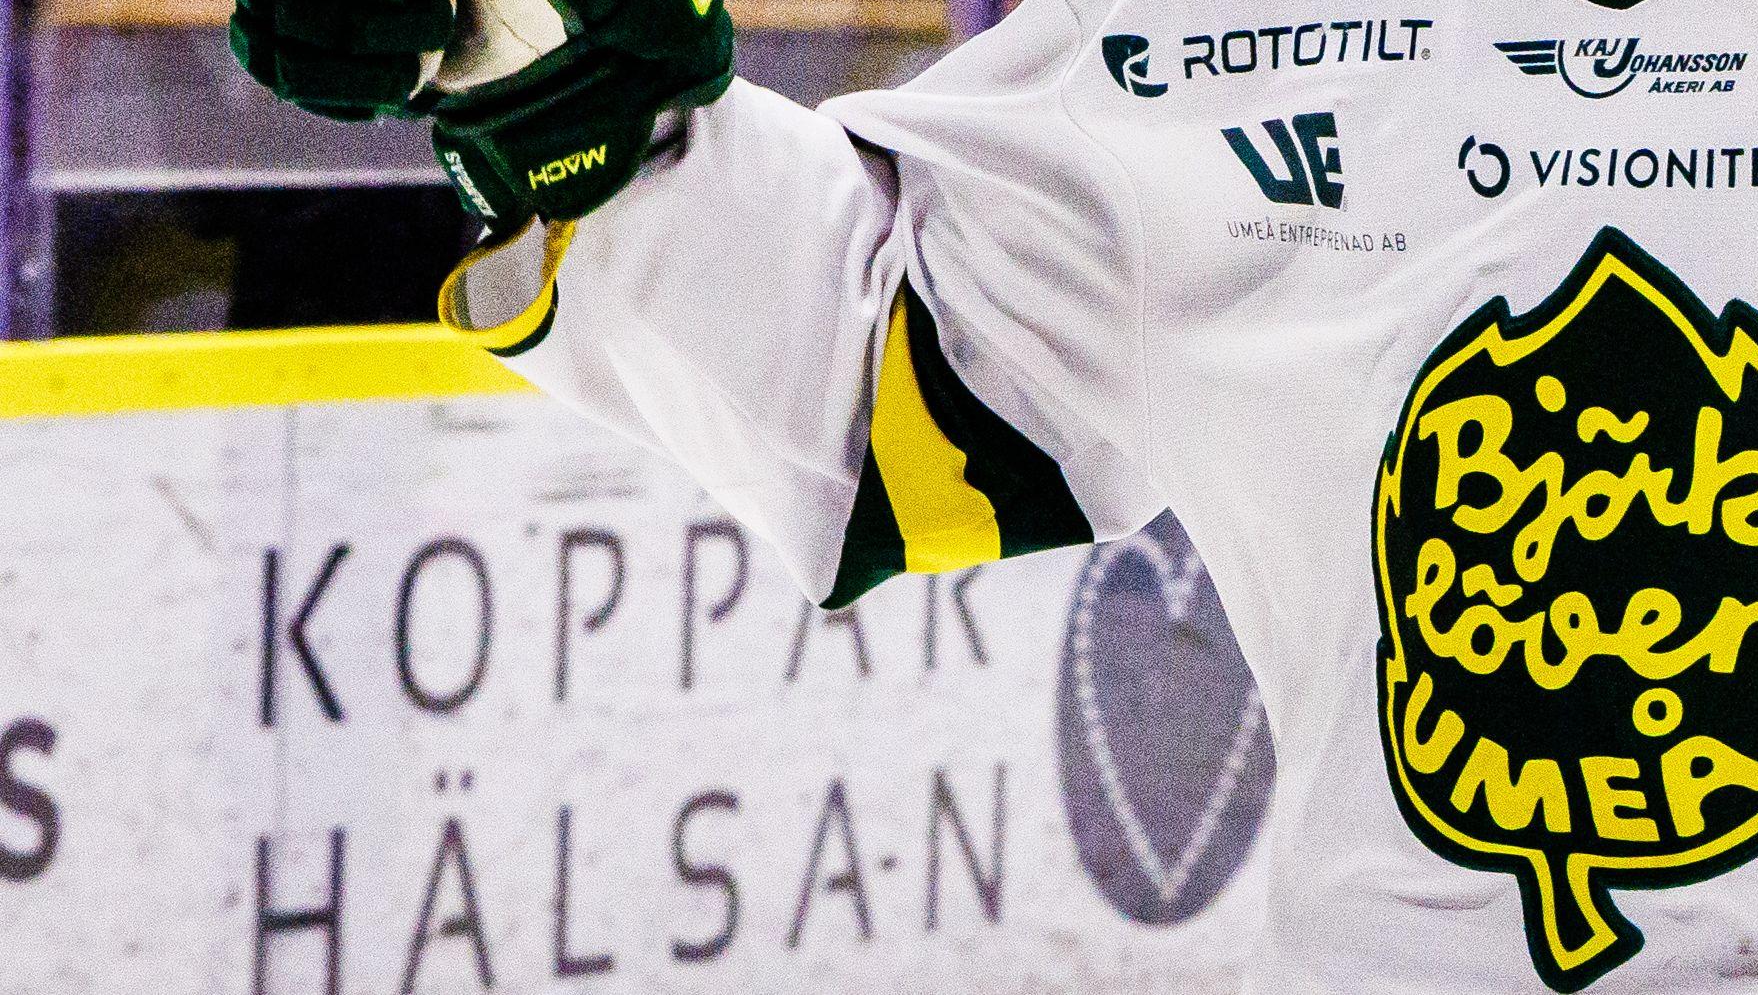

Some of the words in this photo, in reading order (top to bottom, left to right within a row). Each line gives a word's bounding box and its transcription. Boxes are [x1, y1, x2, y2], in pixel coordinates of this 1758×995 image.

[1182, 19, 1434, 80] ROTOTILT
[1575, 38, 1621, 57] KAJ
[1648, 77, 1704, 93] ÅKERI
[1709, 79, 1736, 93] AB
[1227, 216, 1275, 242] UMEÅ
[1280, 222, 1375, 253] ENTREPRENAD
[1382, 232, 1407, 253] AB
[250, 760, 1007, 995] HÄLSAN
